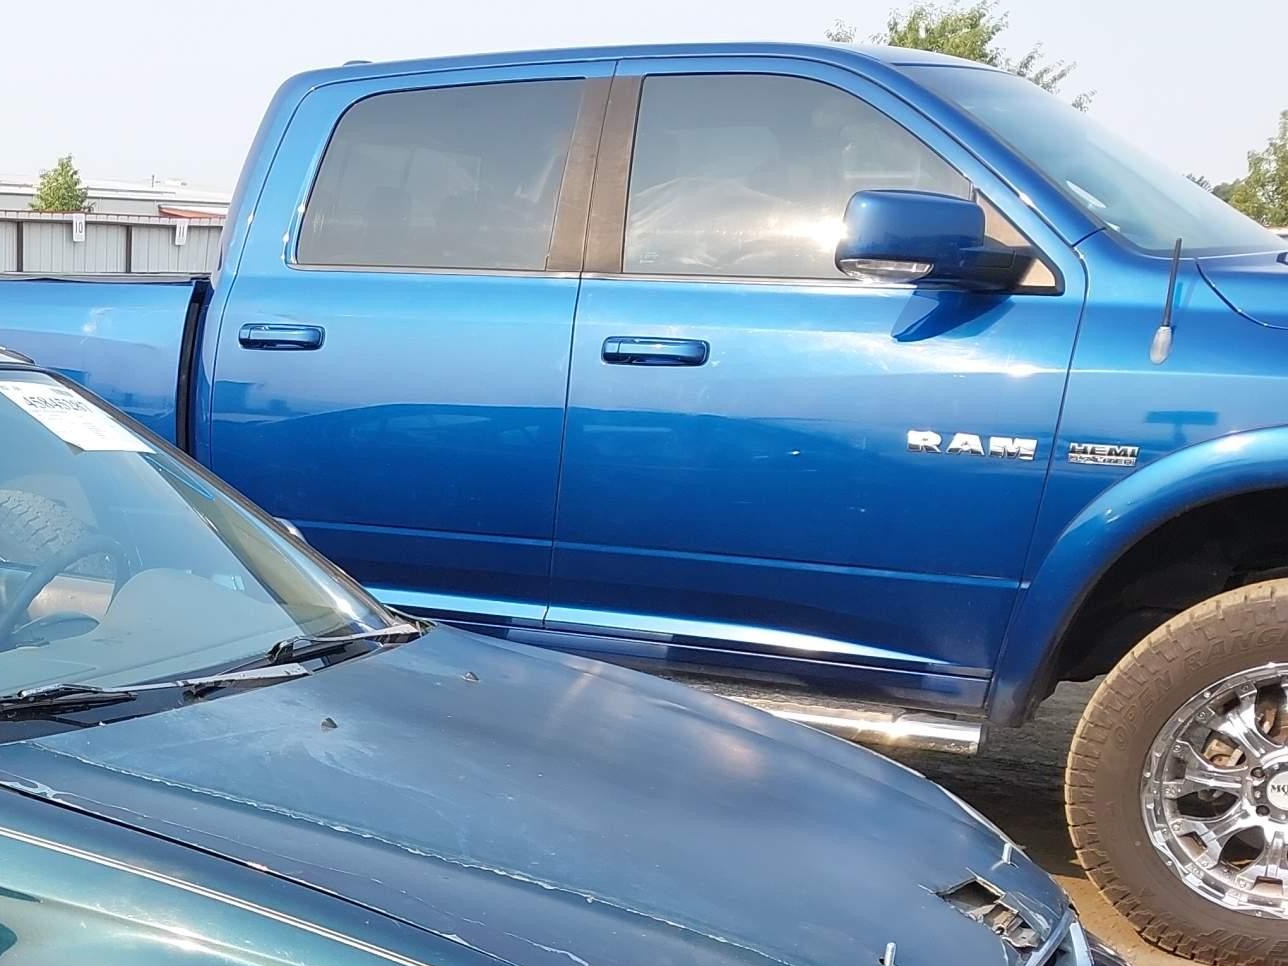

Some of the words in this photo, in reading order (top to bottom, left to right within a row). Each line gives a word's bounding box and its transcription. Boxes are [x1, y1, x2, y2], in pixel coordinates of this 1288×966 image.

[74, 221, 84, 234] 10
[906, 429, 1038, 461] RAM
[1069, 442, 1140, 457] HEMI
[1113, 669, 1174, 752] OPEN
